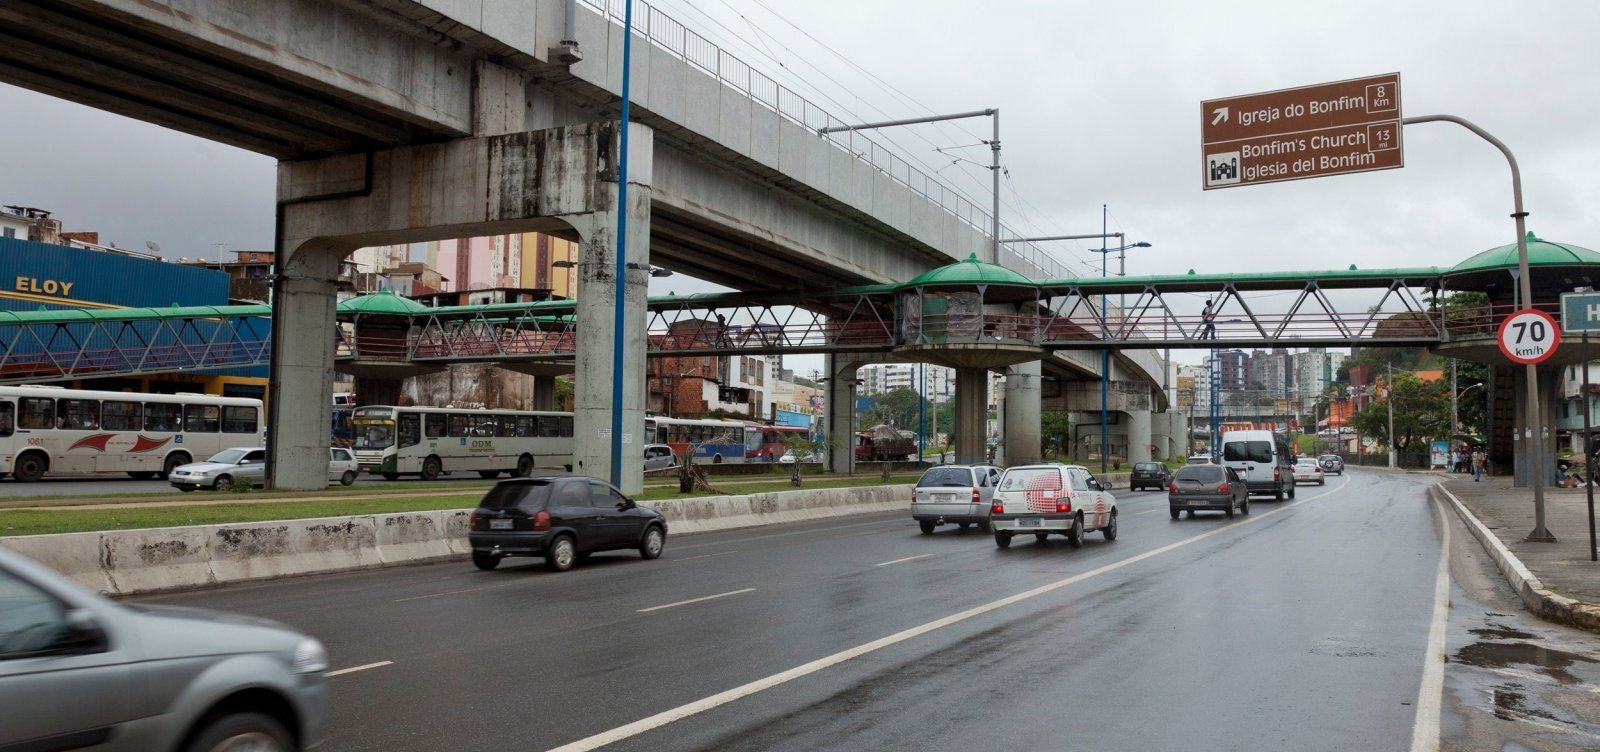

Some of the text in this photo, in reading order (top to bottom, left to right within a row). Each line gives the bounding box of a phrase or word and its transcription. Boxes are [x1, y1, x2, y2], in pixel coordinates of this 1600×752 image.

[1376, 85, 1386, 98] 8
[1373, 97, 1390, 108] Km
[1237, 95, 1365, 126] Igreja do Bonfim
[1375, 129, 1391, 142] 13
[1242, 131, 1366, 158] Bonfim's Church
[1378, 140, 1389, 149] mi
[1242, 151, 1376, 181] Iglesia del Bonfim
[16, 276, 73, 296] ELOY
[1512, 320, 1545, 344] 70
[1515, 345, 1544, 357] km/h
[27, 437, 44, 446] 1061
